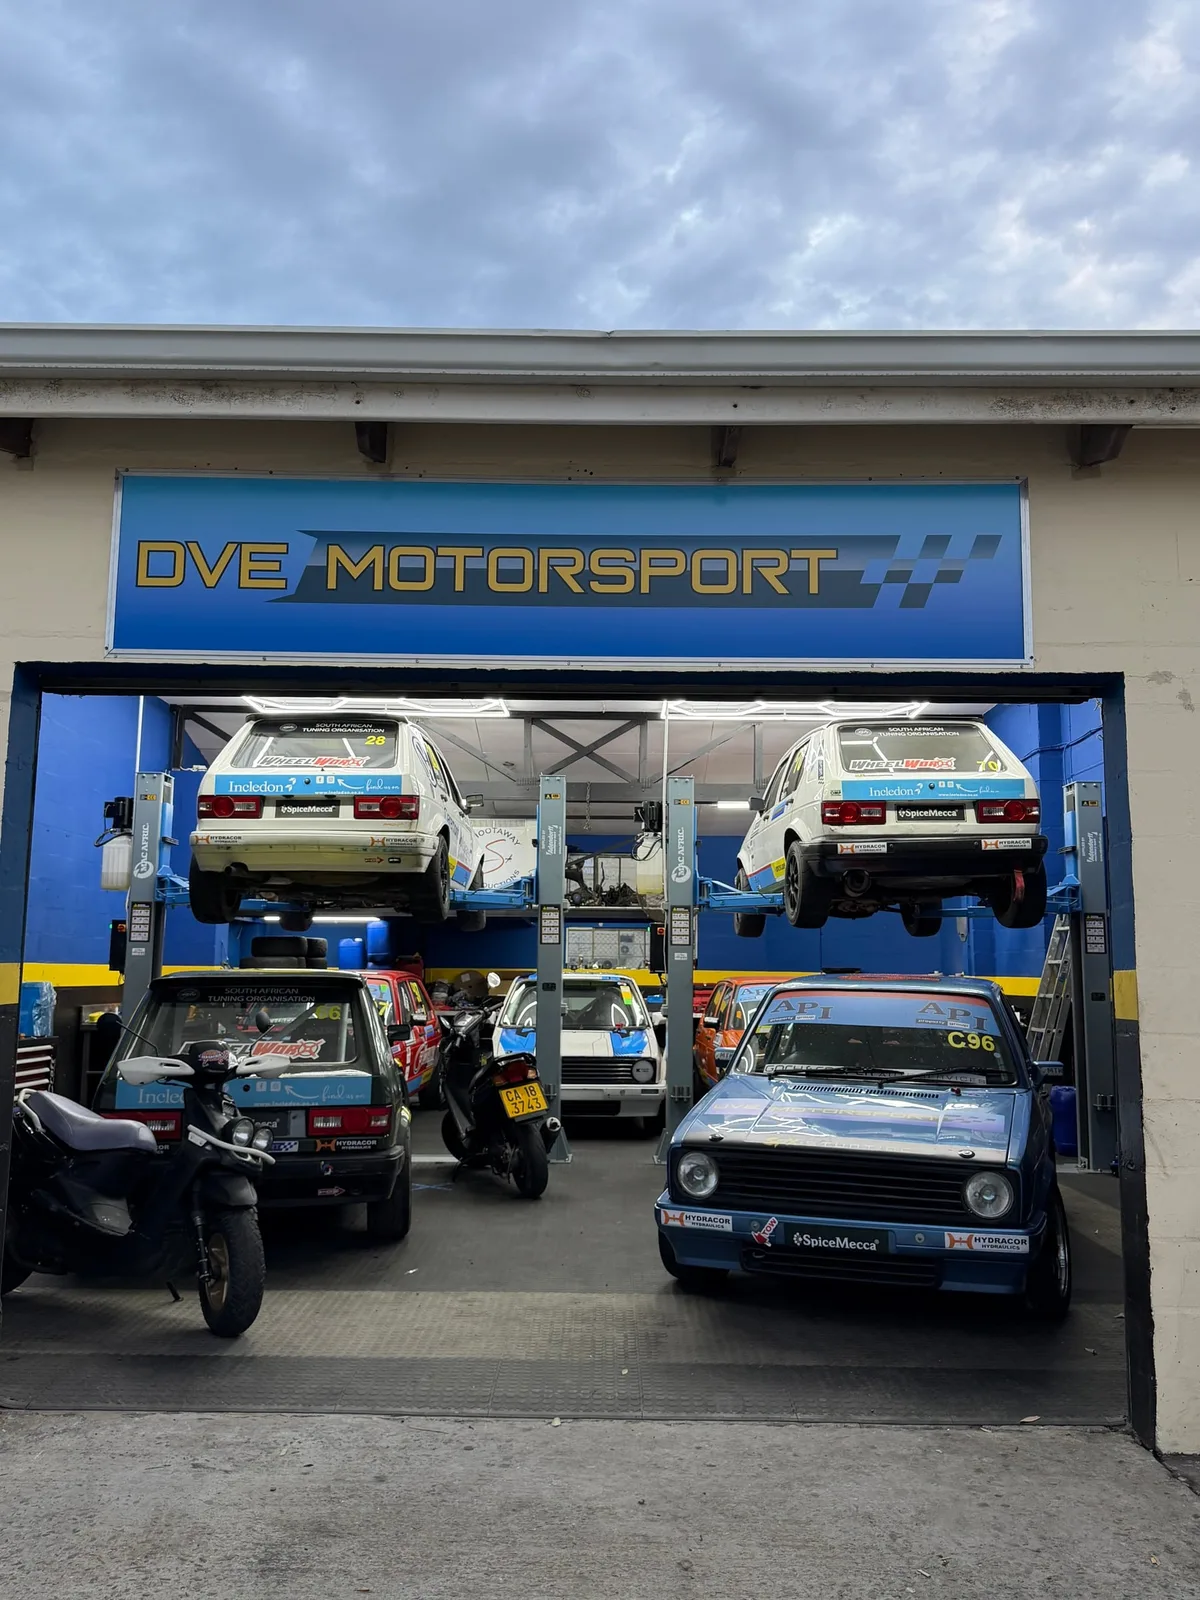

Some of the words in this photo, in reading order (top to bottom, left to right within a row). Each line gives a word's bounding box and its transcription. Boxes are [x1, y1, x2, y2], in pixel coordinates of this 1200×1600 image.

[135, 540, 289, 589] DVE
[325, 543, 839, 595] MOTORSPORT
[365, 735, 386, 745] 28
[976, 760, 999, 771] 70
[228, 781, 285, 793] Incledon
[869, 786, 914, 797] Incledon
[287, 805, 334, 814] SpiceMecca
[905, 809, 957, 819] SpiceMecca
[475, 828, 521, 846] OOTAWAY
[770, 1000, 833, 1020] API
[917, 1002, 988, 1032] API
[947, 1031, 996, 1052] C96
[138, 1088, 185, 1104] Incle
[505, 1089, 522, 1102] CA
[524, 1086, 537, 1097] 18
[511, 1098, 541, 1114] 3743
[685, 1215, 731, 1225] HYDRACOR
[763, 1218, 777, 1236] TOW
[803, 1234, 877, 1251] SpiceMecca
[974, 1236, 1028, 1246] HYDRACOR
